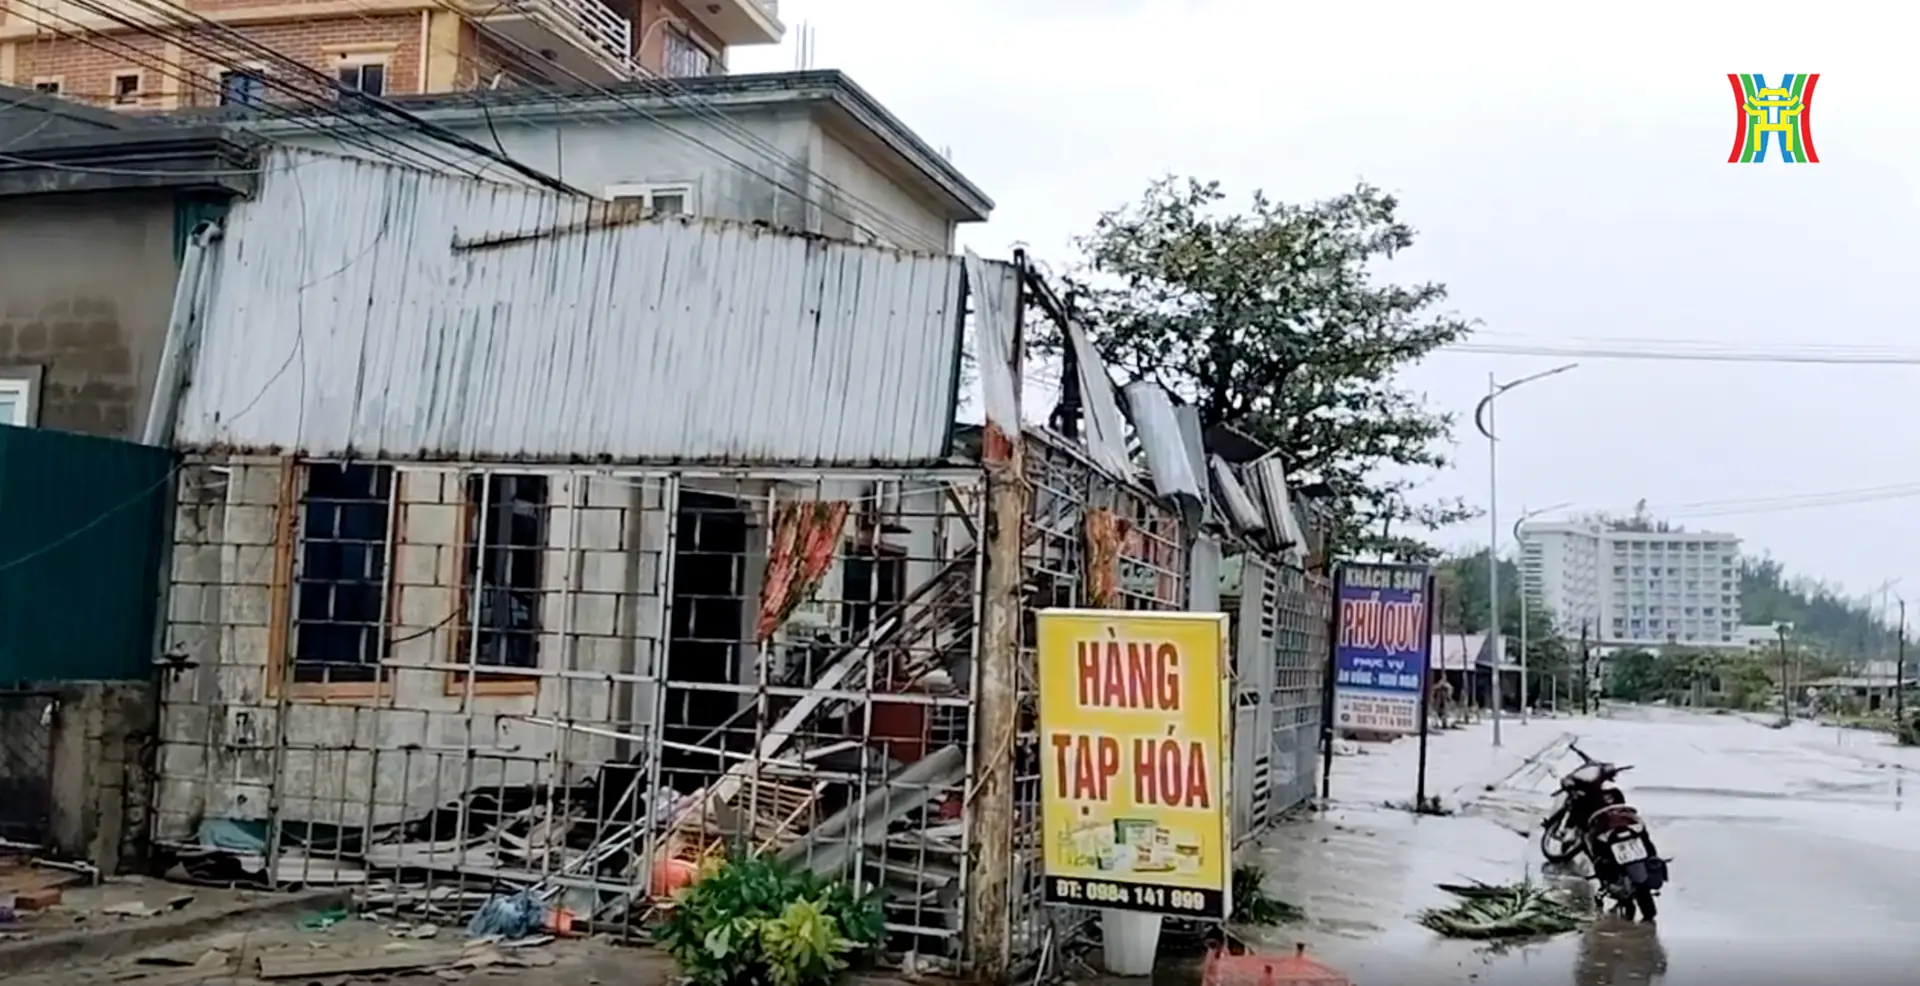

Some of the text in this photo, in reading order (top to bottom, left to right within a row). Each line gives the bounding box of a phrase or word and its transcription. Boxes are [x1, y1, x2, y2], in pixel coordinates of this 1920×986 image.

[1345, 566, 1391, 588] KHÁCH
[1340, 590, 1382, 649] PHÚ
[1077, 627, 1180, 711] HÀNG
[1052, 725, 1209, 815] TẠP HÓA
[1056, 879, 1083, 899] ĐT:
[1134, 886, 1165, 907] 141
